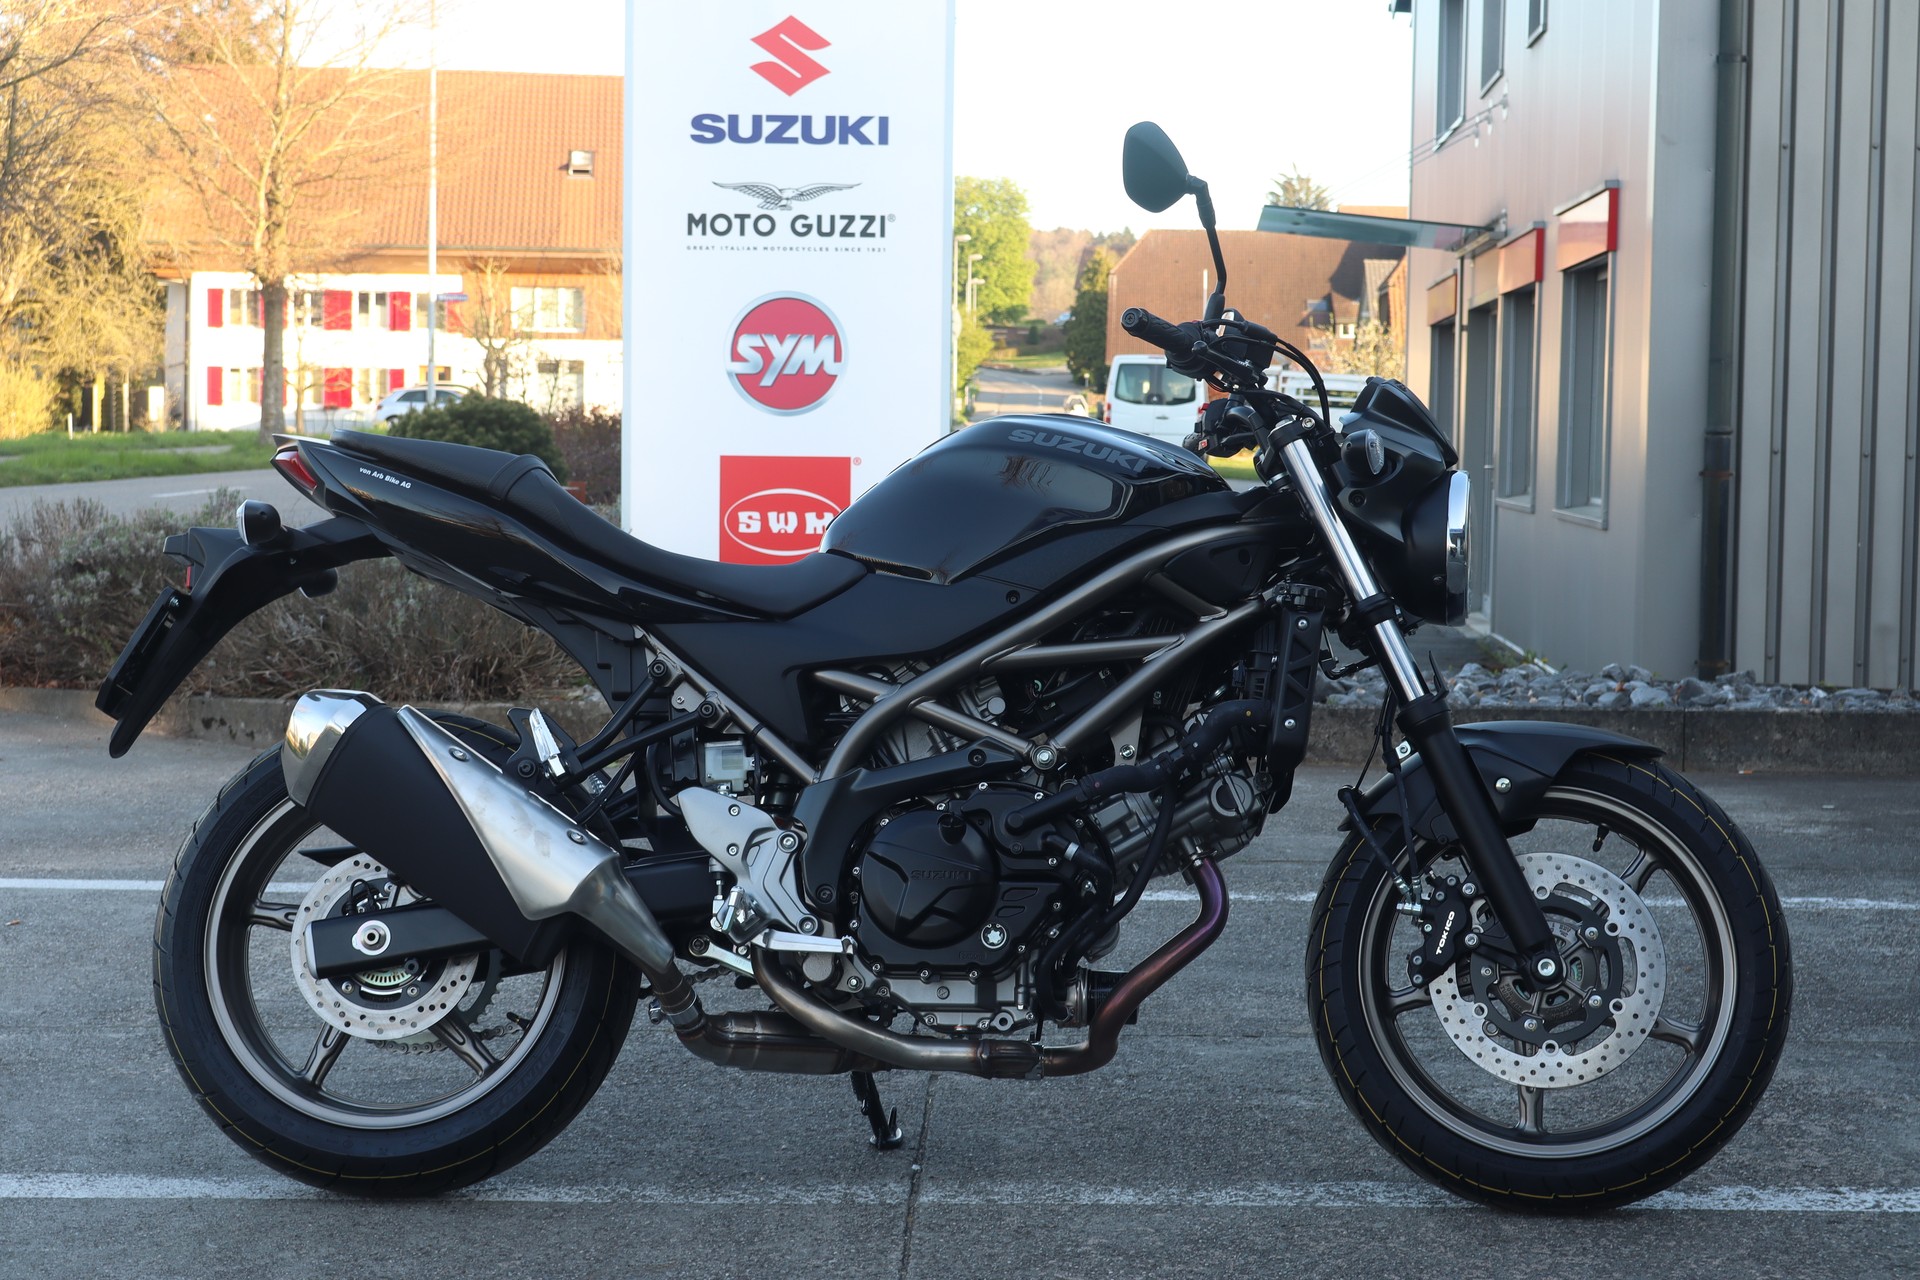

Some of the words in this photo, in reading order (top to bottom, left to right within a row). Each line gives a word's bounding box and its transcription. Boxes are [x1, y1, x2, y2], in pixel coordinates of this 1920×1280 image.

[690, 113, 889, 146] SUZUKI
[687, 213, 776, 237] MOTO
[727, 333, 842, 387] SYM
[1007, 428, 1149, 474] SUZUKI
[360, 467, 371, 475] von
[372, 471, 384, 479] Arb
[385, 475, 400, 484] Bike
[738, 511, 834, 535] SWM
[910, 869, 971, 881] SUZUKI
[1435, 911, 1455, 955] TOKICO
